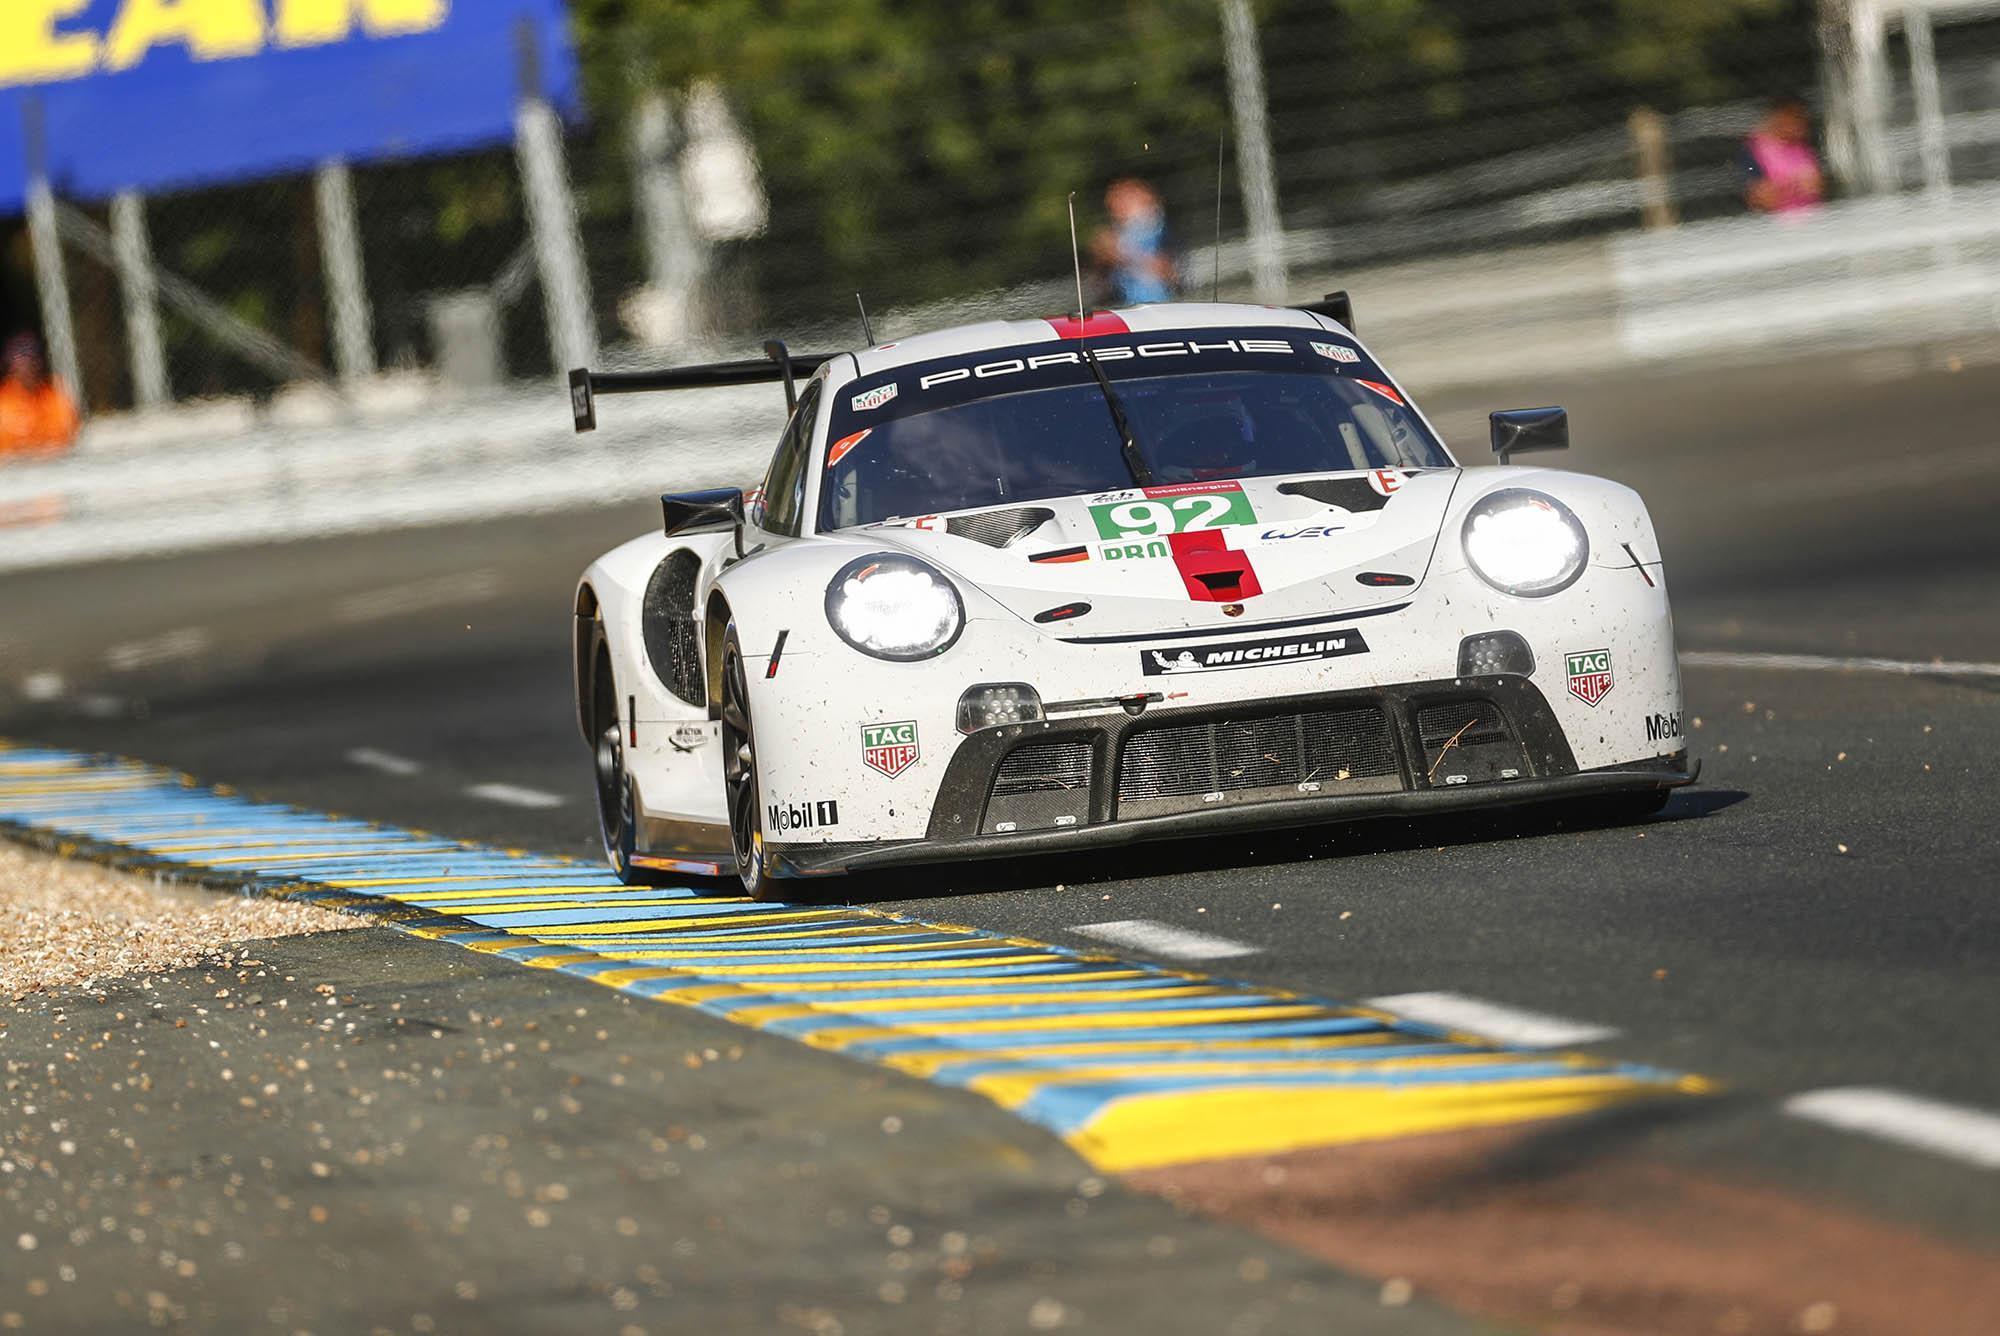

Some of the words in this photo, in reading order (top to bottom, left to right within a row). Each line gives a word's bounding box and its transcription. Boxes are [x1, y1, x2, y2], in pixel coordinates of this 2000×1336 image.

[920, 339, 1294, 391] PORSCHE
[1110, 494, 1240, 539] 92
[1260, 526, 1346, 540] WEC
[1104, 541, 1168, 560] PRO
[1205, 638, 1346, 665] MICHELIN
[1570, 655, 1608, 673] TAG
[1571, 674, 1611, 701] HEUER
[866, 726, 913, 745] TAG
[867, 747, 915, 771] HEUER
[768, 802, 813, 836] Mobil
